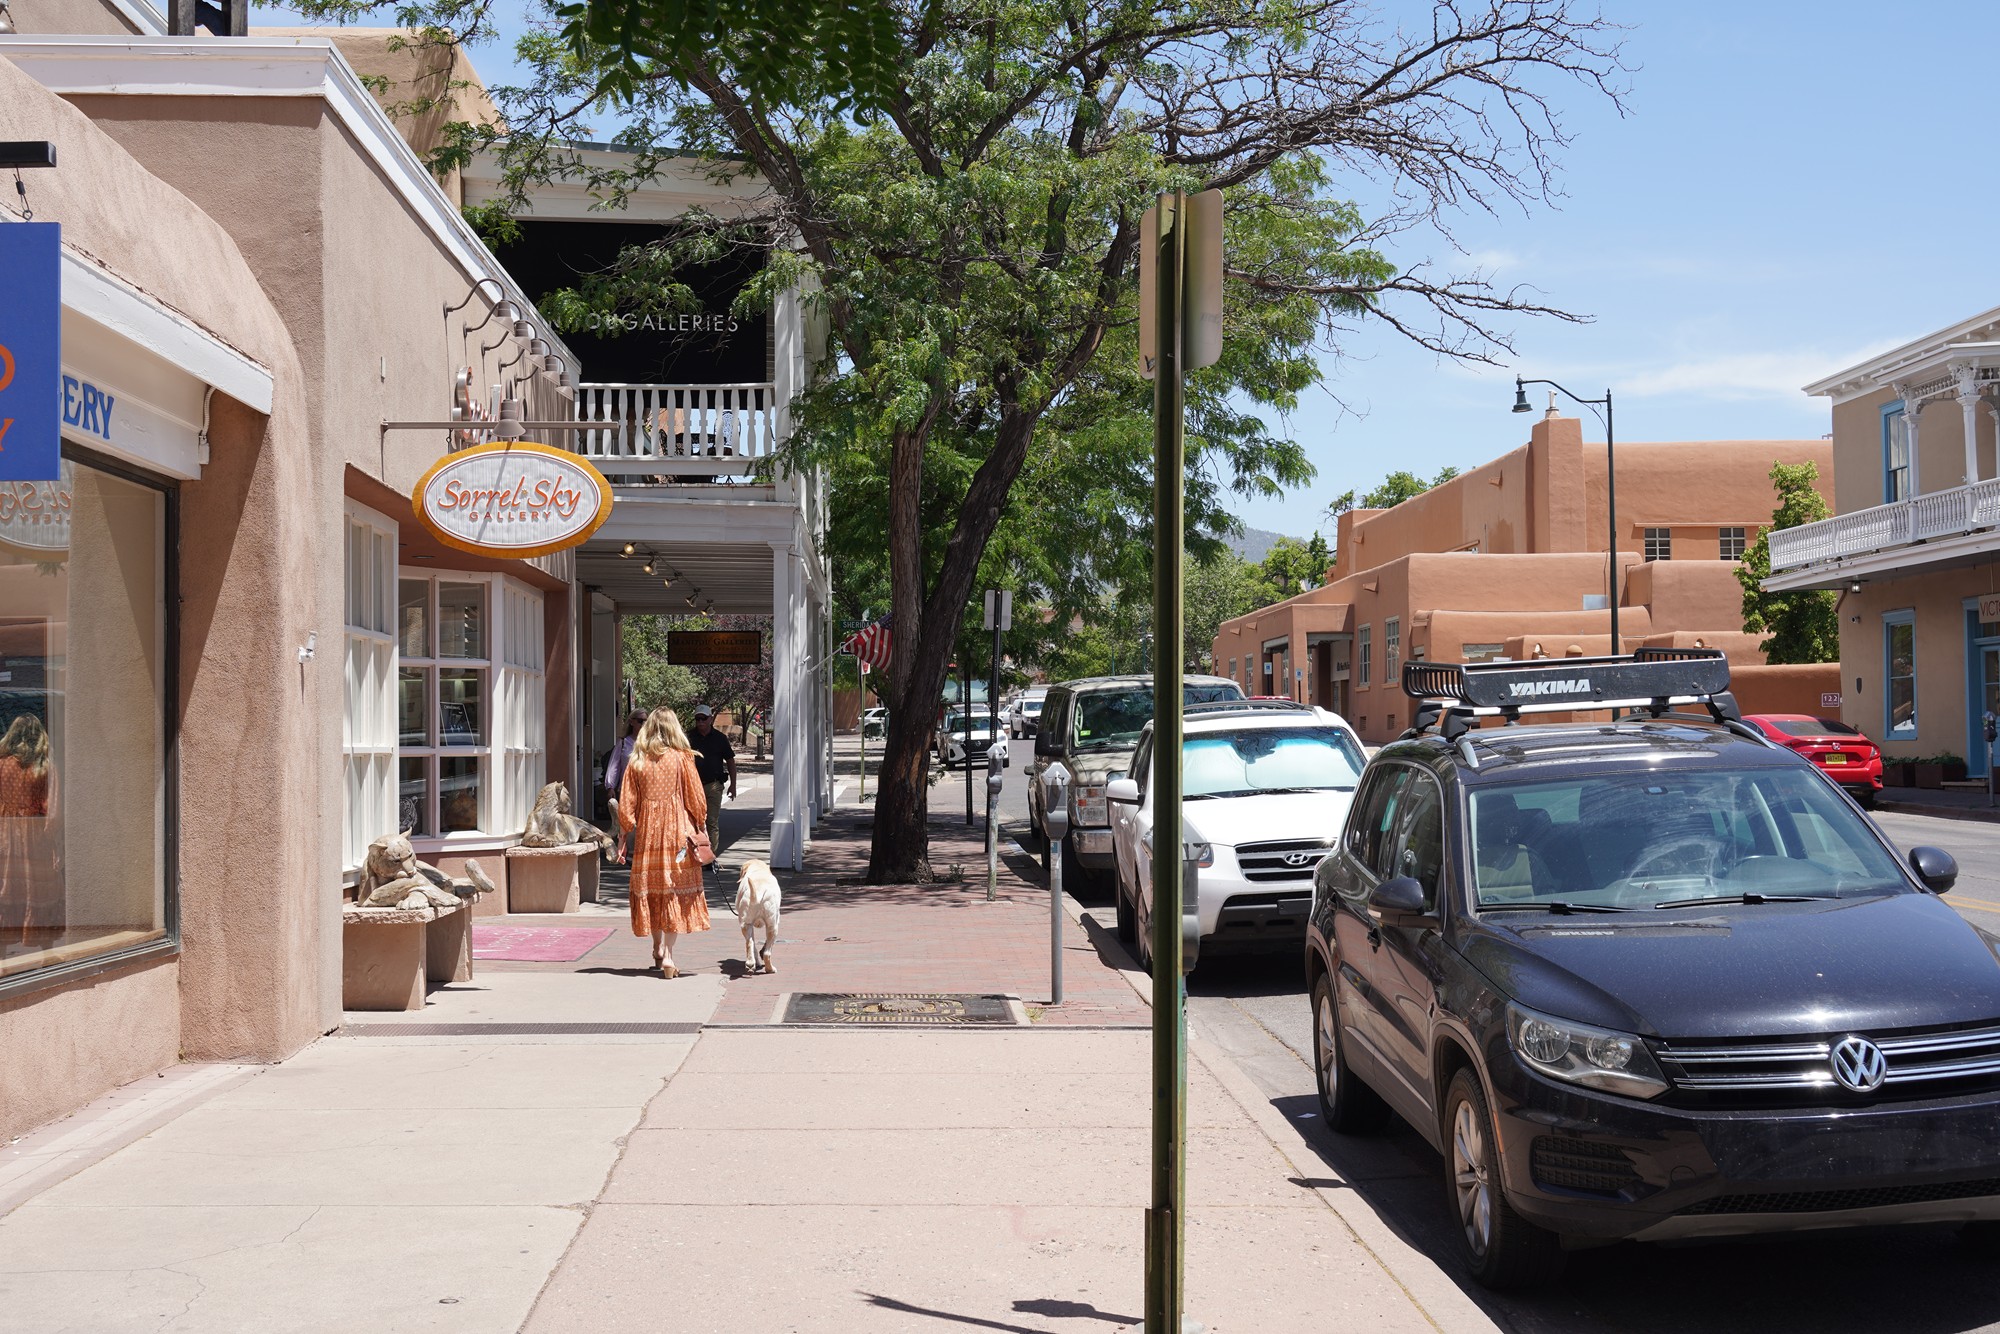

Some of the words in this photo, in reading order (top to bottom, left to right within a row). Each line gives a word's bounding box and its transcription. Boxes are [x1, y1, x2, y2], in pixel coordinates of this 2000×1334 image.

[627, 312, 739, 332] GALLERIES
[60, 373, 115, 440] ERY
[437, 475, 525, 509] Sorrel
[527, 474, 582, 518] Sky
[469, 511, 551, 521] GALLERY
[1979, 600, 2000, 617] VICT
[1508, 678, 1591, 697] YAKIMA
